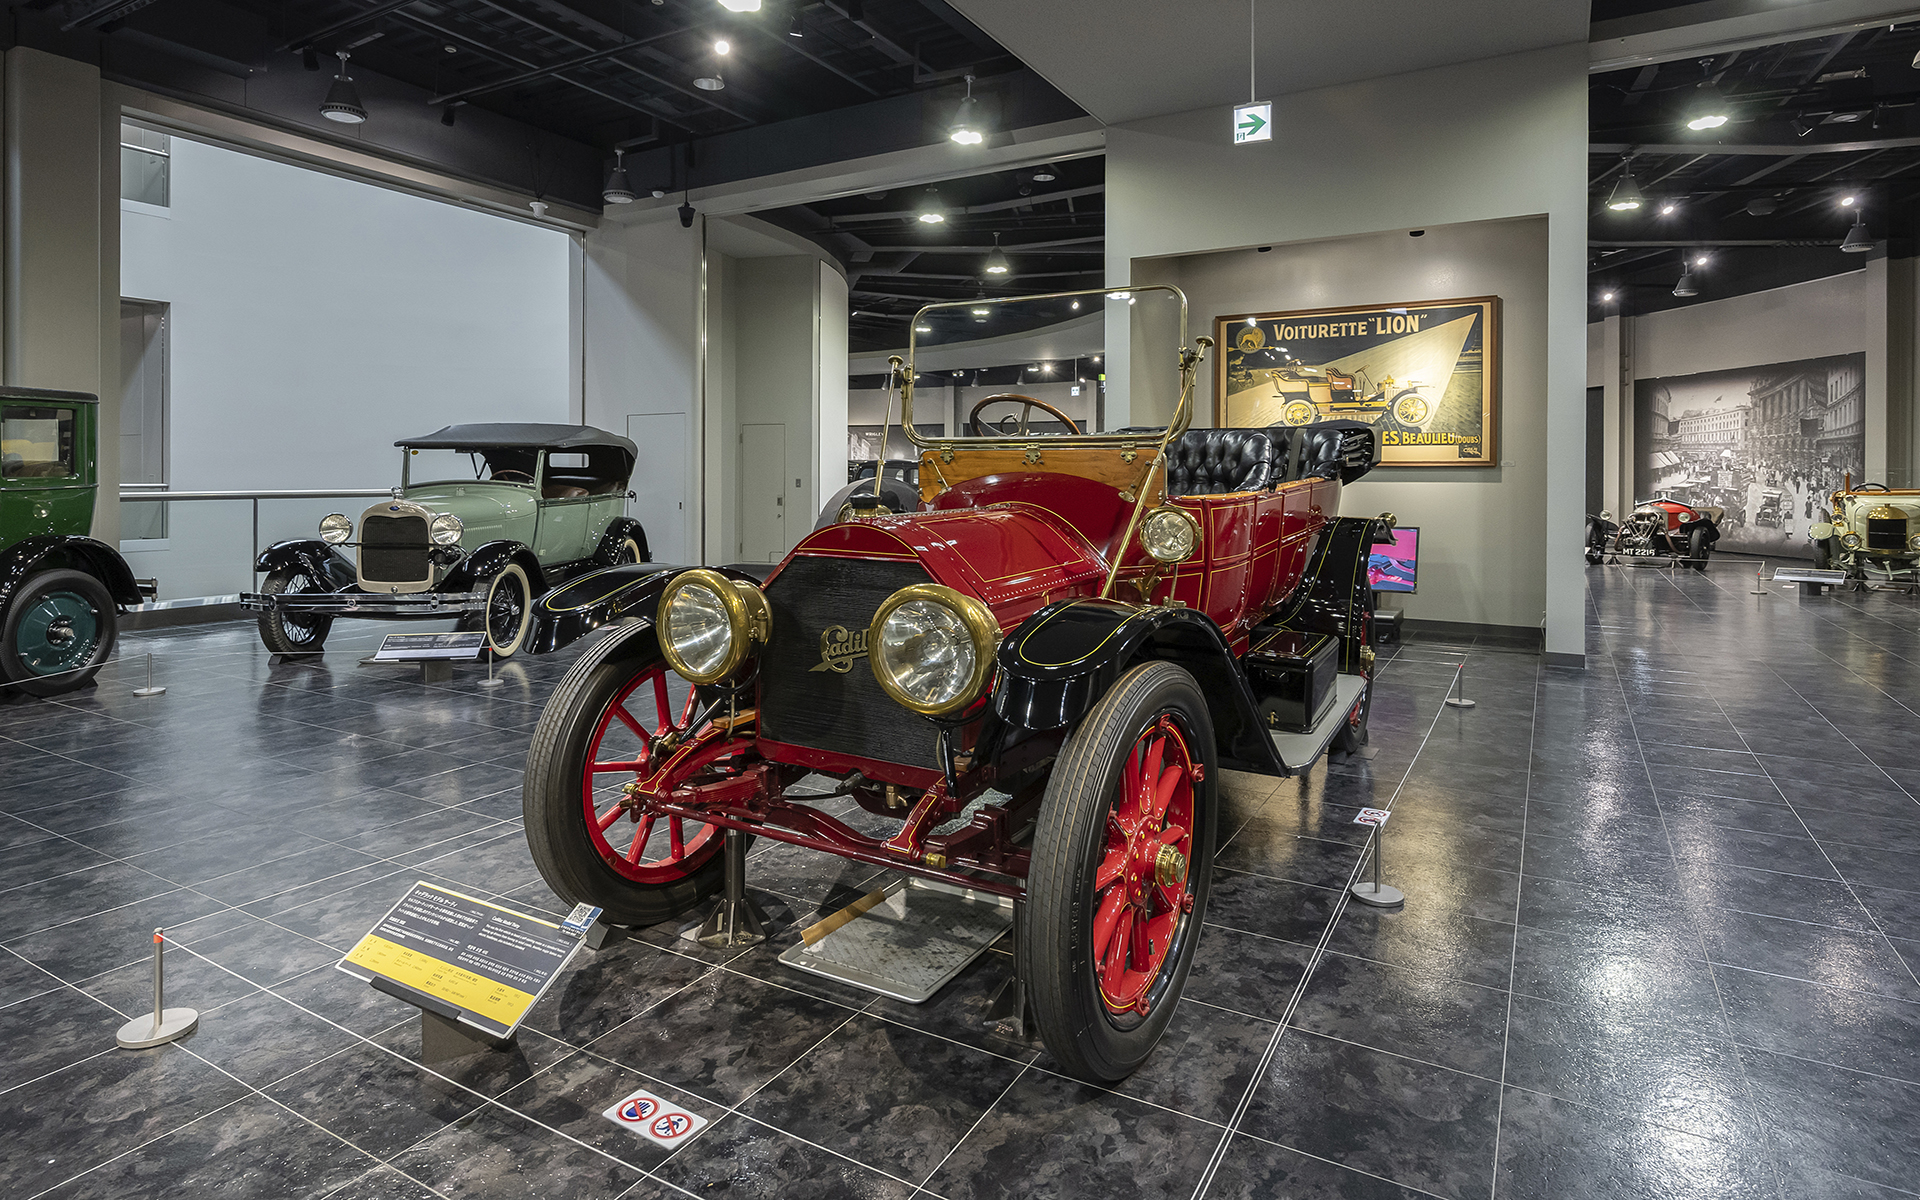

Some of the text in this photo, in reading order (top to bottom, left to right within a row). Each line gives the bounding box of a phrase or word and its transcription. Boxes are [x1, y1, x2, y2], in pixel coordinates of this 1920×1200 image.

[1273, 314, 1428, 341] VOITURETTE "LION"
[1382, 430, 1482, 446] ES. BEAULIEU (DOUBS)
[808, 625, 869, 674] Cadil
